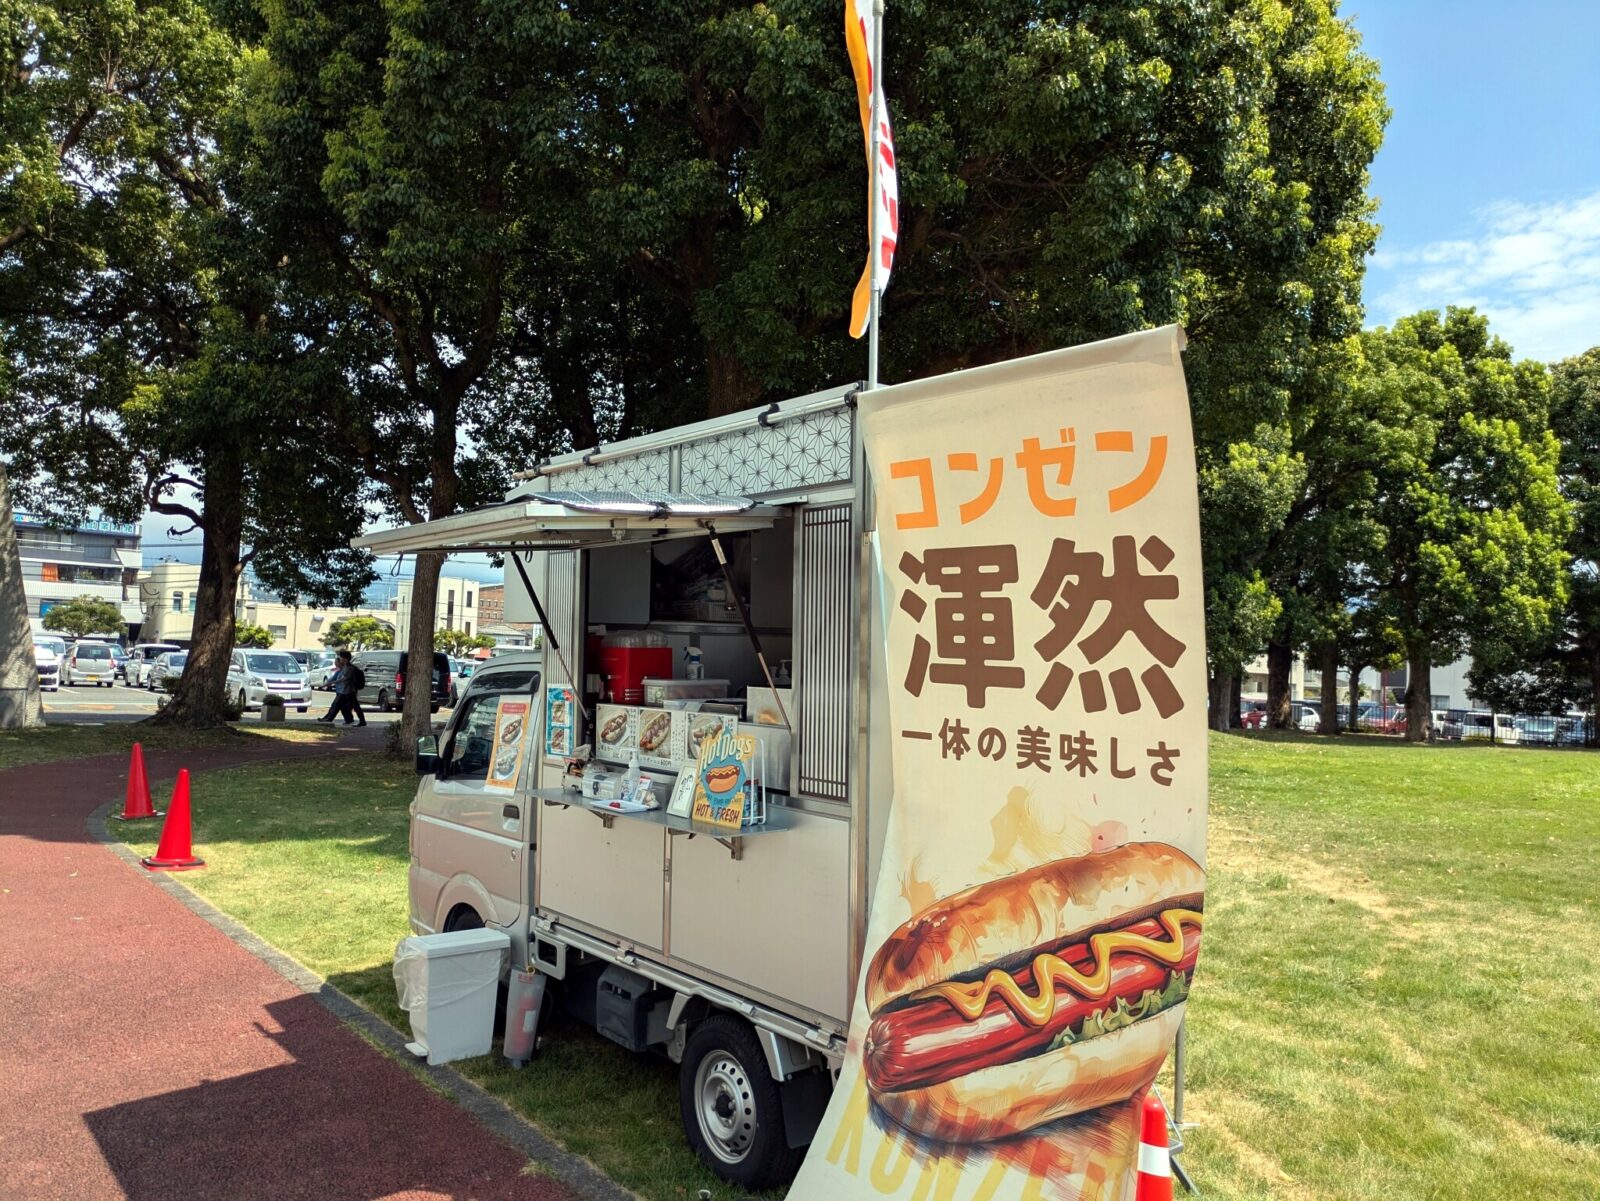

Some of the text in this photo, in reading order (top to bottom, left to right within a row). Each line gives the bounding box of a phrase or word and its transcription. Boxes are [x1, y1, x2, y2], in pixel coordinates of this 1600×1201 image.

[891, 429, 1167, 529] コンゼン
[899, 536, 1186, 719] 渾然
[700, 735, 721, 774] Hot
[720, 734, 753, 762] Dogs
[902, 718, 1180, 786] 一体の美味しさ
[694, 803, 711, 817] HOT
[715, 806, 741, 824] FRESH
